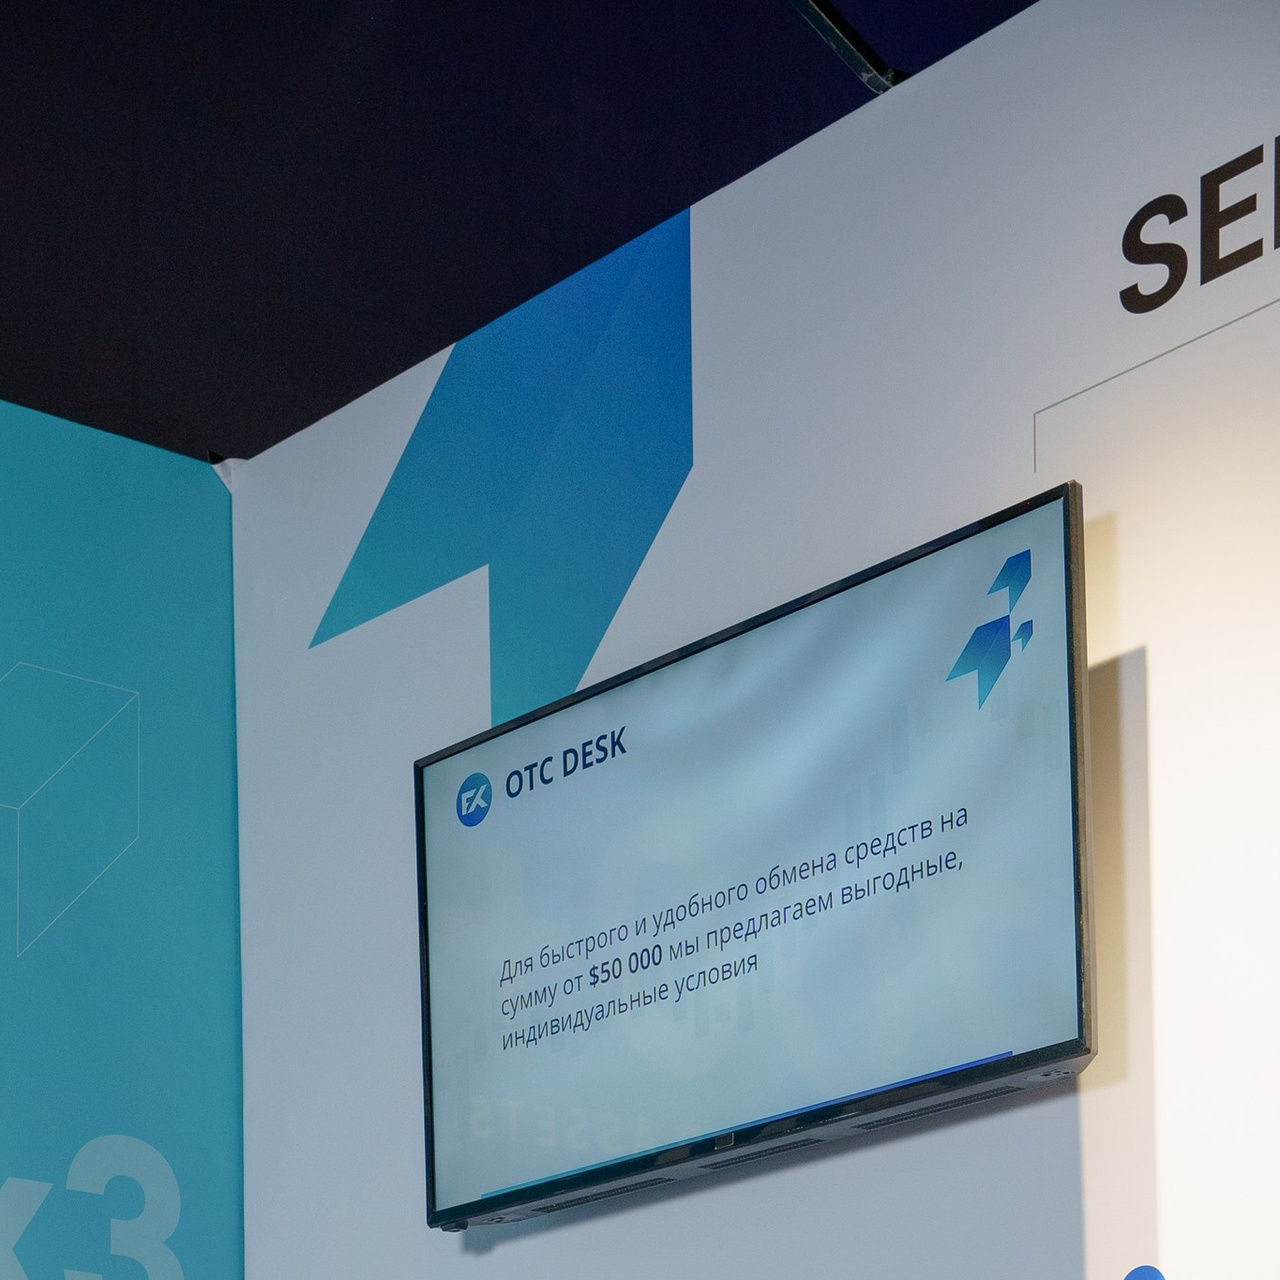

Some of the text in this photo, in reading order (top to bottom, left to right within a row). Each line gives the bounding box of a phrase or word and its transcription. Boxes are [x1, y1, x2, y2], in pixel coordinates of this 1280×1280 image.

[1119, 134, 1280, 315] SE
[505, 756, 554, 799] OTC
[562, 725, 627, 778] DESK
[499, 807, 969, 988] Для быстрого и удобного обмена средств на
[500, 850, 964, 1020] сумму от $50 000 мы предлагаем выгодные,
[502, 953, 758, 1051] индивидуальные условия
